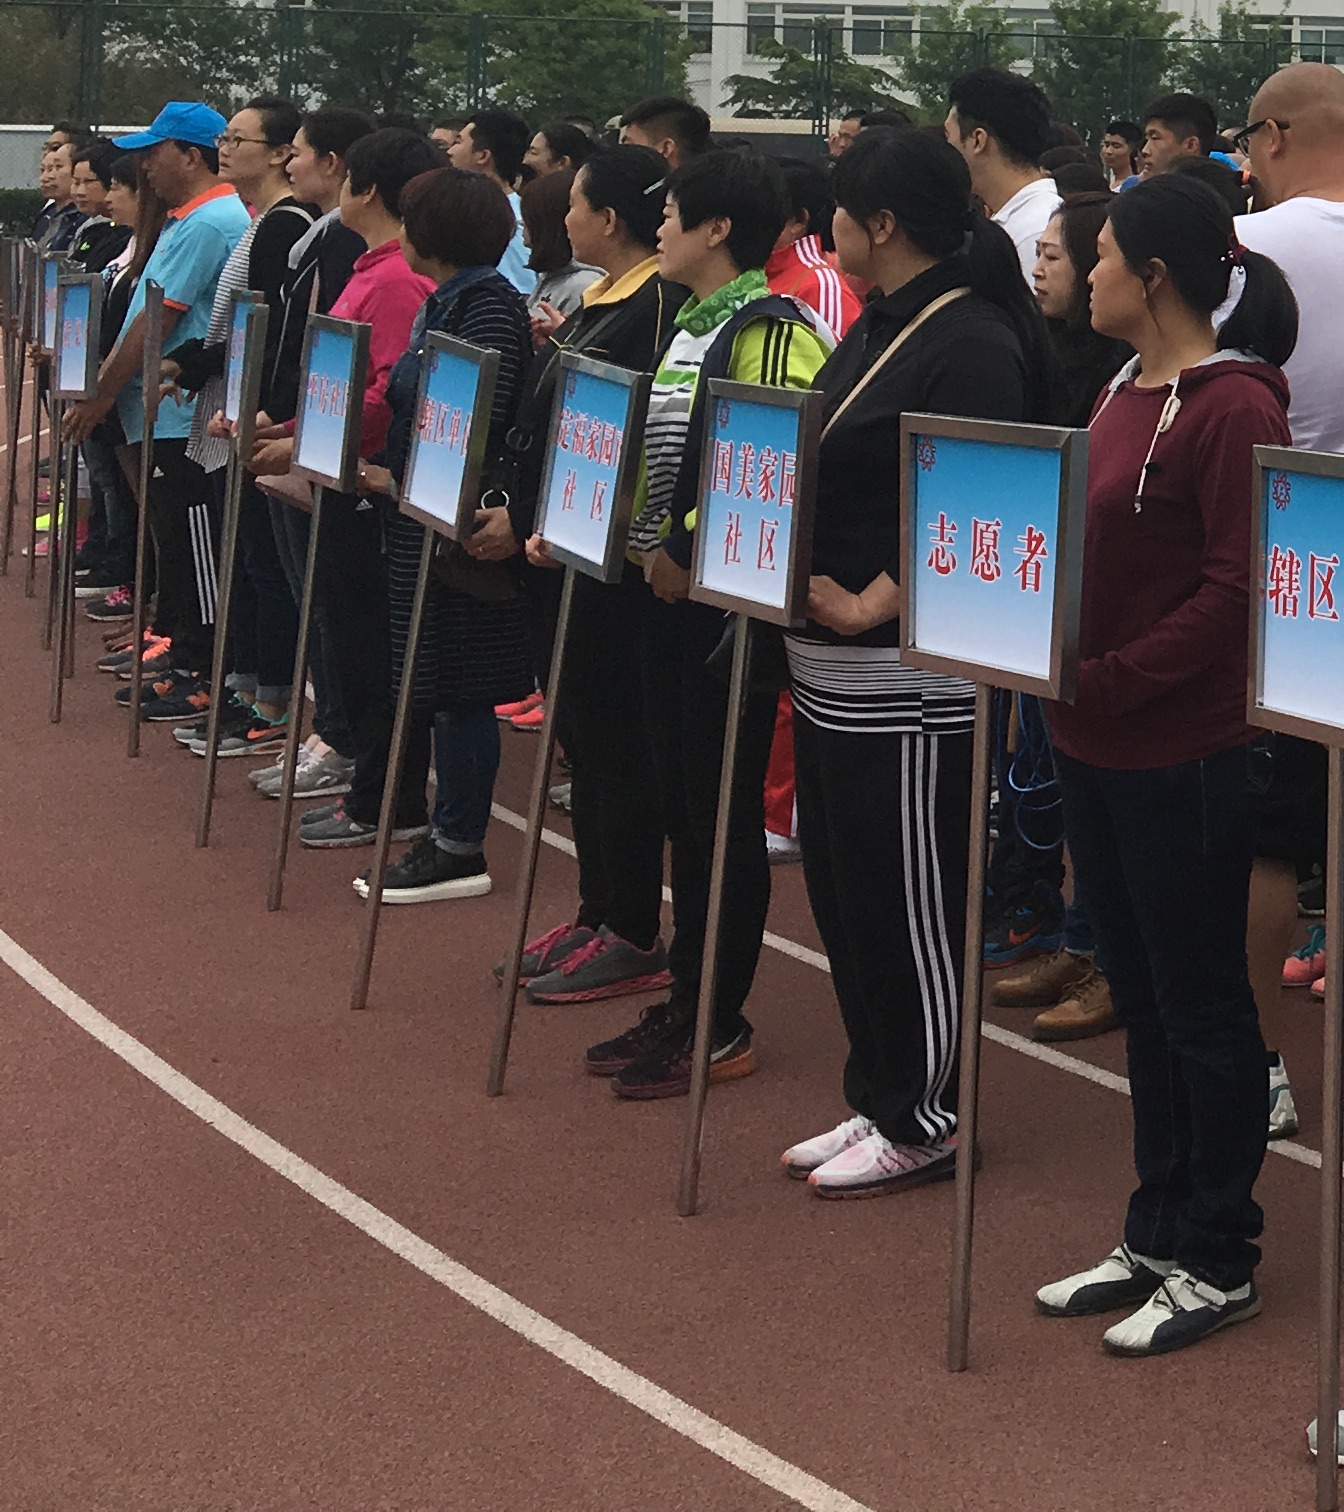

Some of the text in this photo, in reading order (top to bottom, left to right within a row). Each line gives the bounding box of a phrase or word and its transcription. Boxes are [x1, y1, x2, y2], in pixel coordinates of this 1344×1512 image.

[712, 439, 797, 509] 国美家园
[723, 511, 780, 572] 社区
[927, 511, 1049, 594] 志愿者
